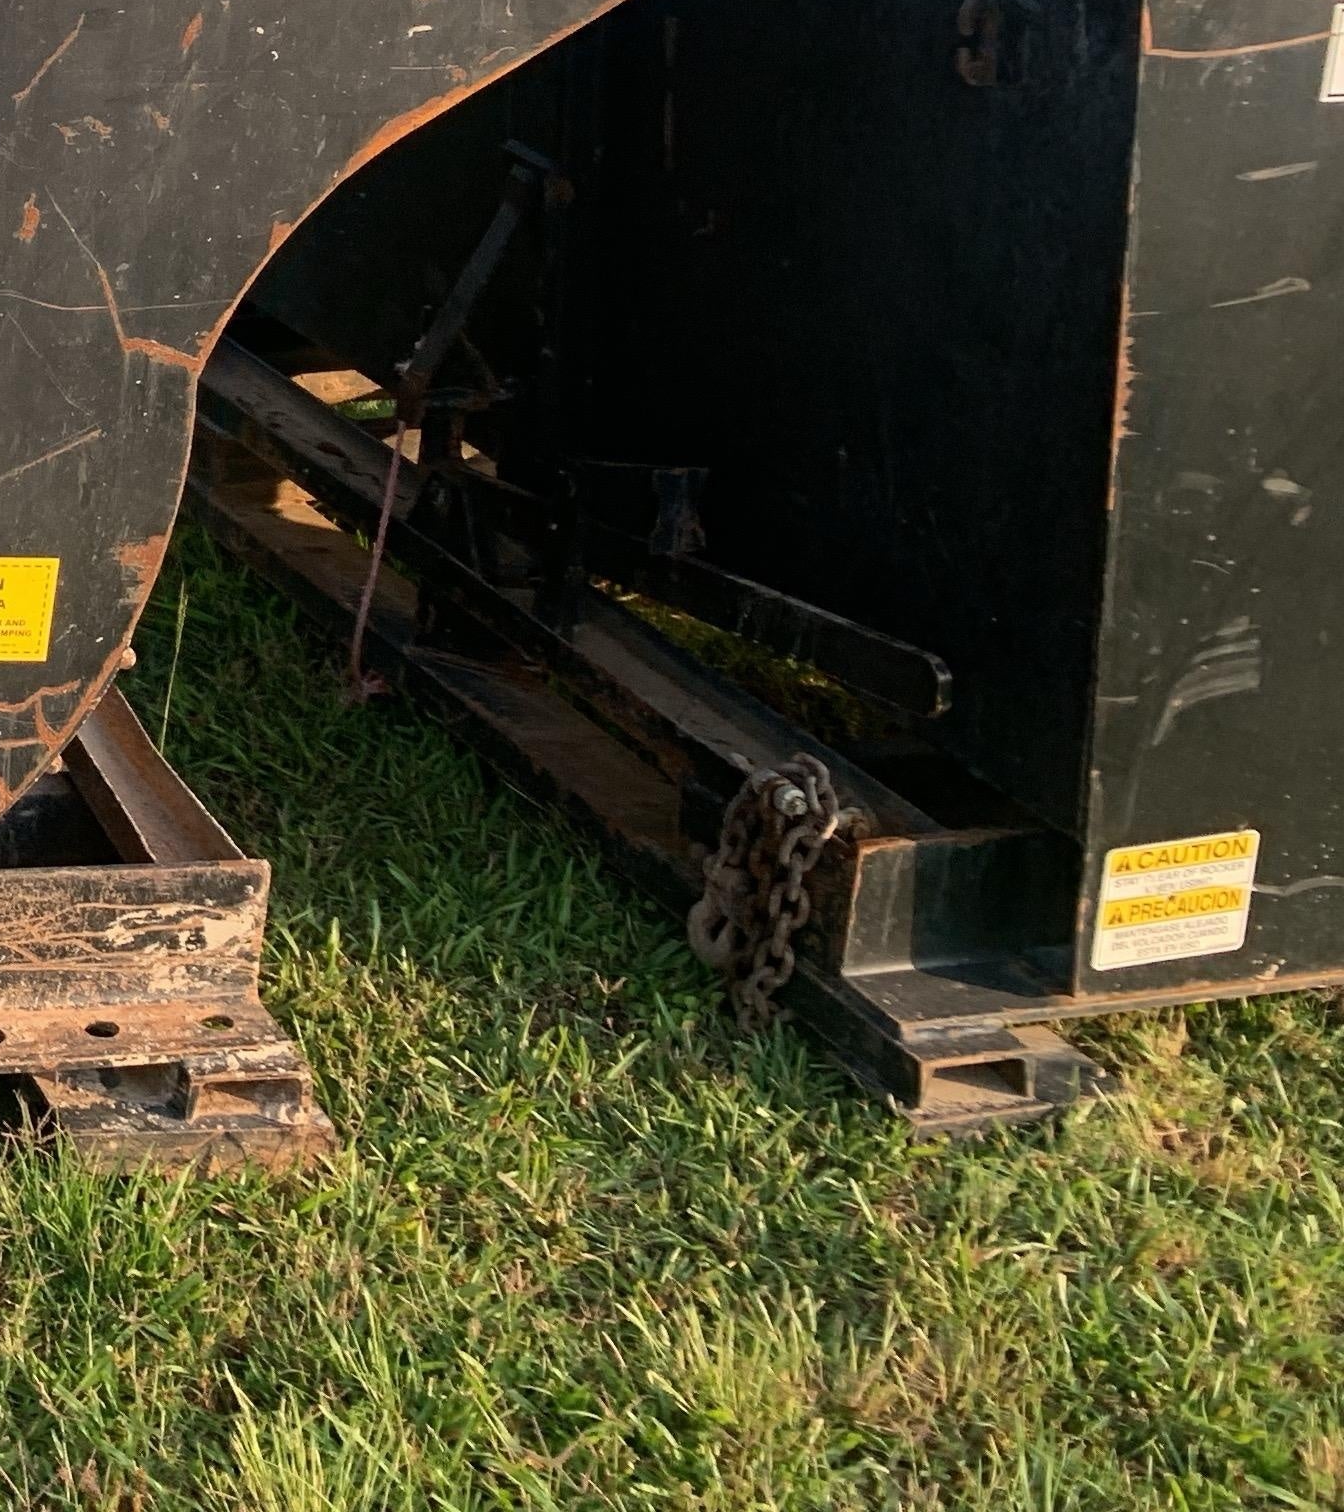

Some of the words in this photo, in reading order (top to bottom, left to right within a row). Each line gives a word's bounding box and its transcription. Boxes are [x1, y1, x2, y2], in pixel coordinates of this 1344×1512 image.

[5, 619, 27, 627] AND
[1137, 837, 1250, 870] CAUTION
[1128, 888, 1243, 922] PRECAUCION
